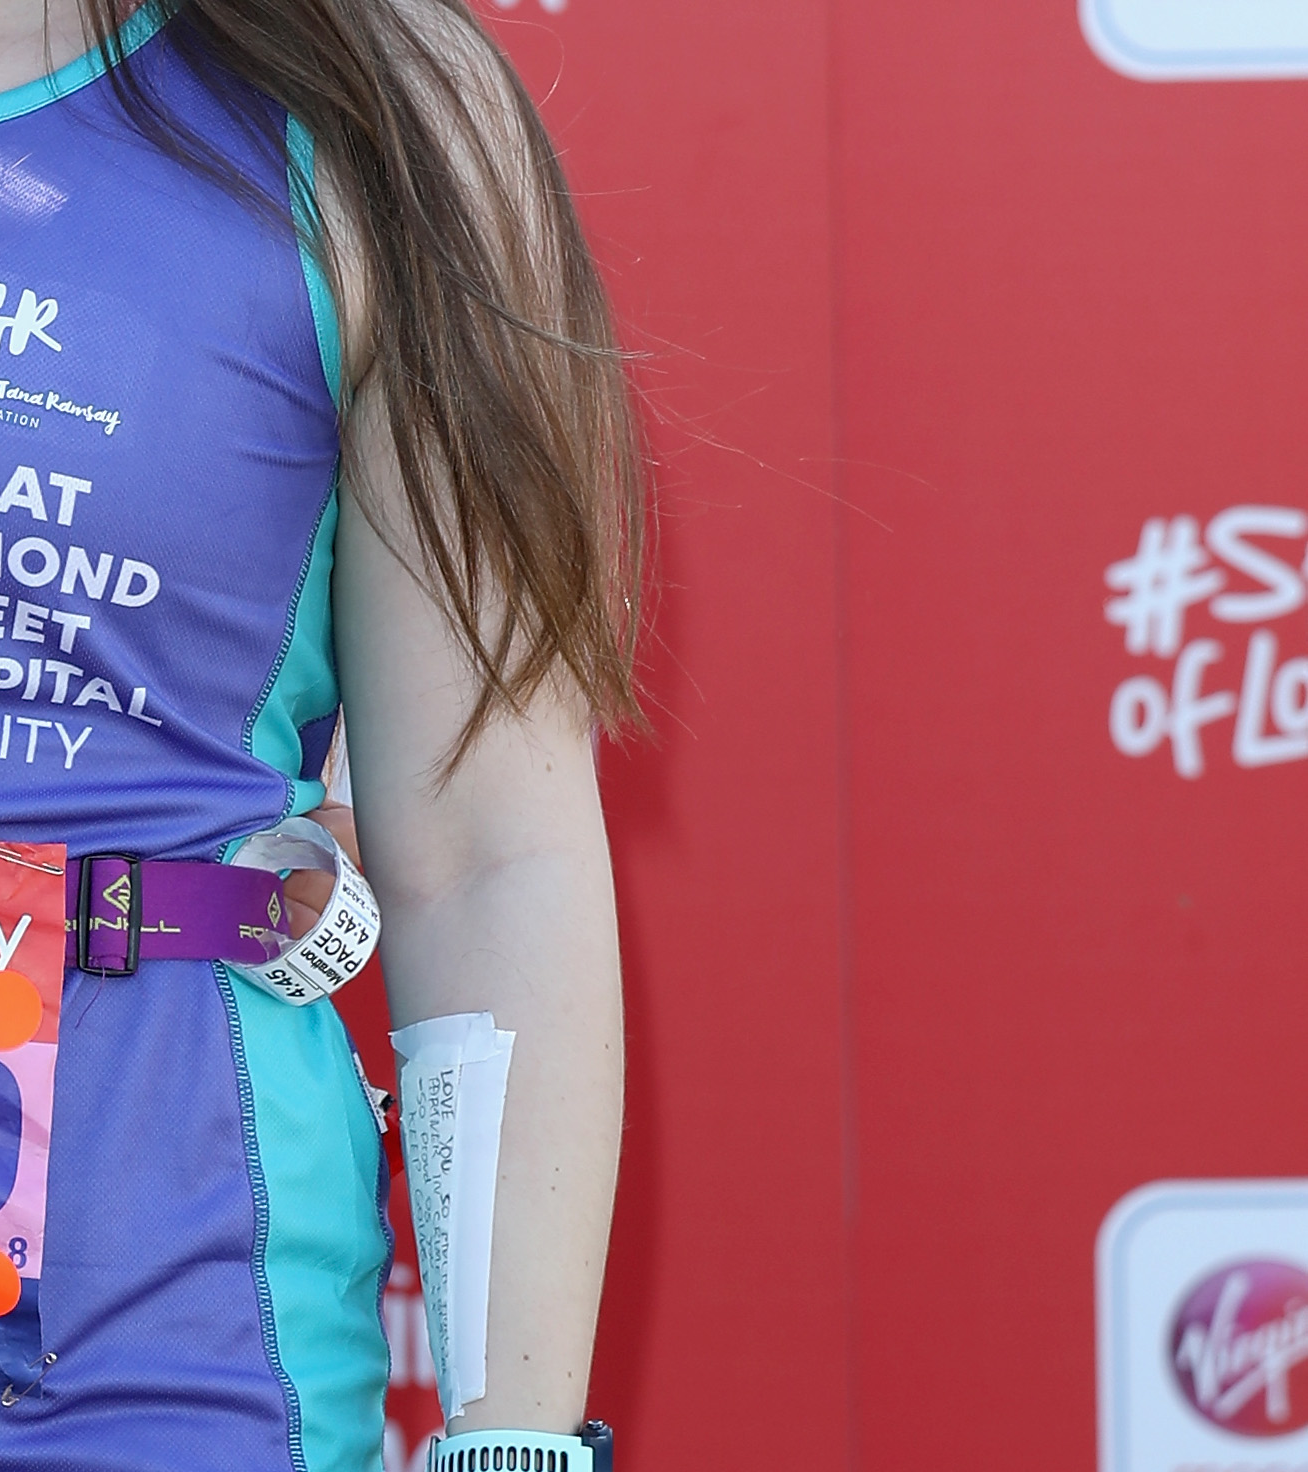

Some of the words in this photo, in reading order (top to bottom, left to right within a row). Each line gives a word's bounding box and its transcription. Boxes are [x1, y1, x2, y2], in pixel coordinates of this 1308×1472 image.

[45, 391, 121, 435] Ramsay
[1108, 637, 1236, 781] of
[335, 909, 370, 945] 4:45
[300, 946, 344, 986] Marathon
[313, 928, 363, 973] PACE
[265, 969, 305, 997] 4:45
[441, 1069, 456, 1121] LOVE
[7, 1236, 29, 1271] 8
